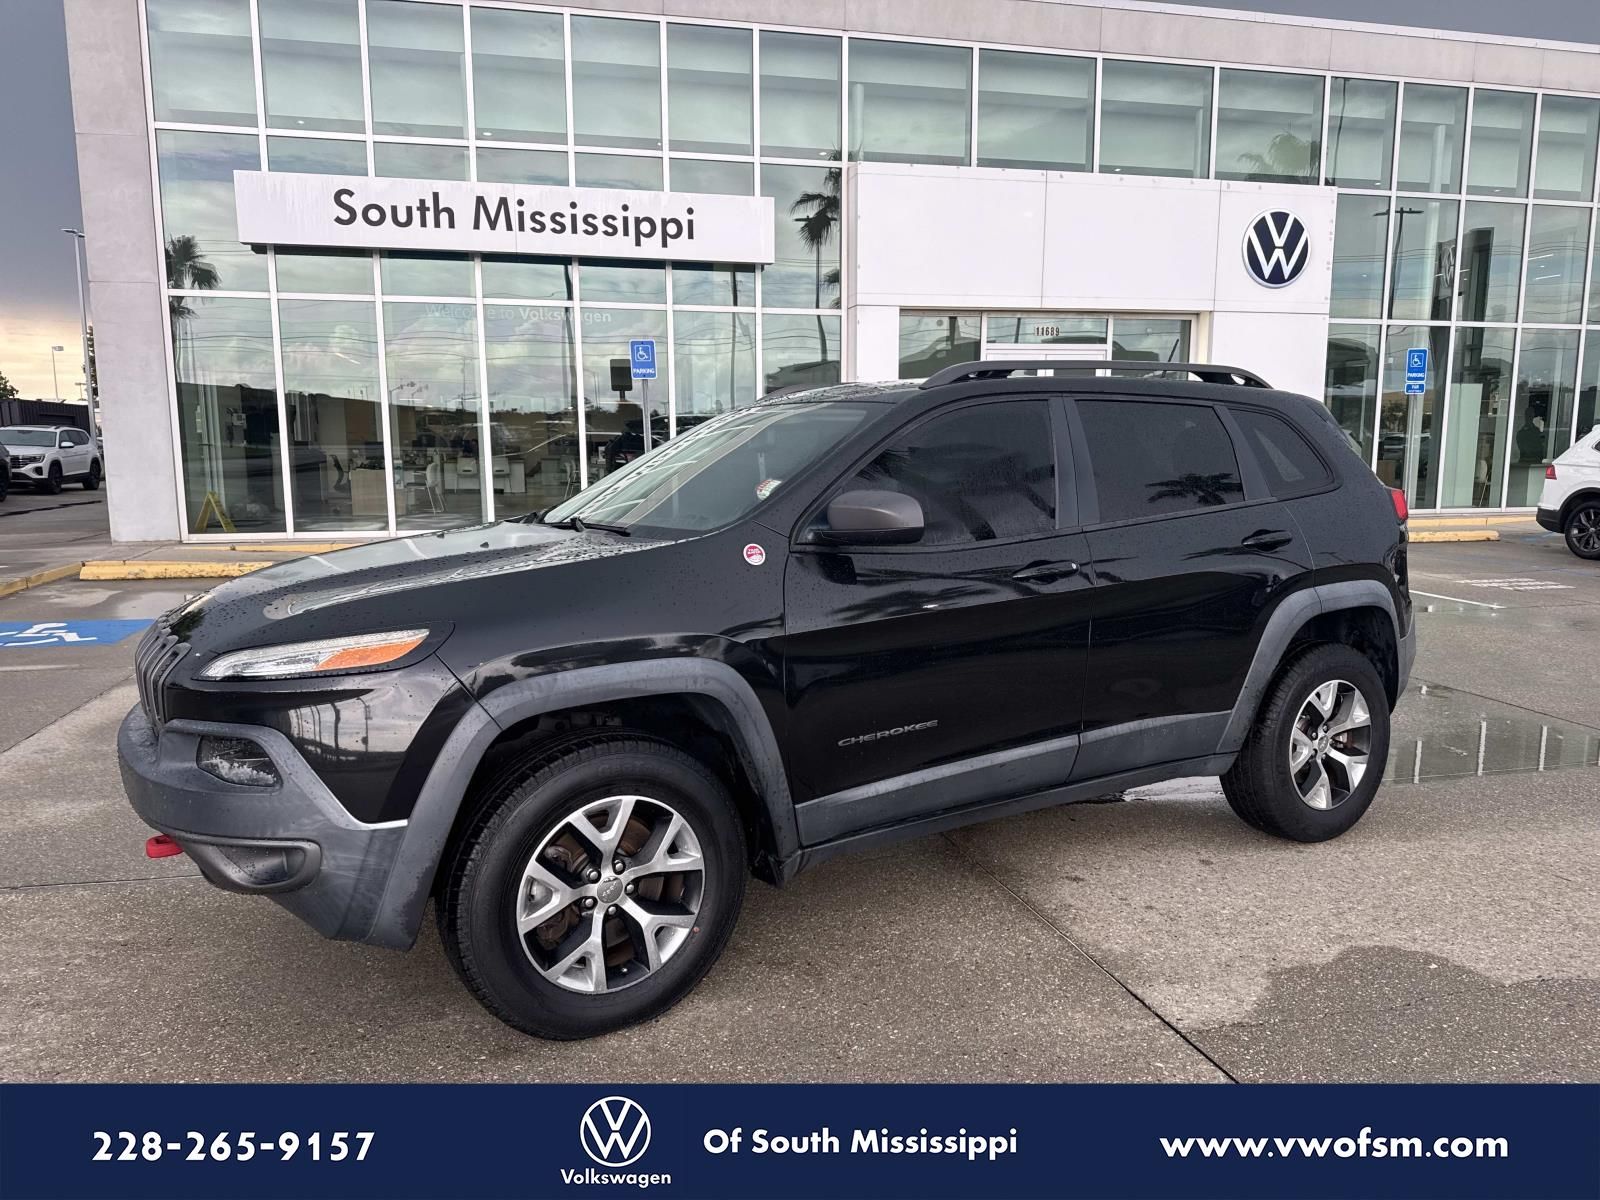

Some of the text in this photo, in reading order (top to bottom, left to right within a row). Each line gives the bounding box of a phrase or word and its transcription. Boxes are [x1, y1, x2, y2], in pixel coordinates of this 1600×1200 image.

[333, 189, 696, 249] South Mississippi
[838, 719, 938, 747] CHEROKEE
